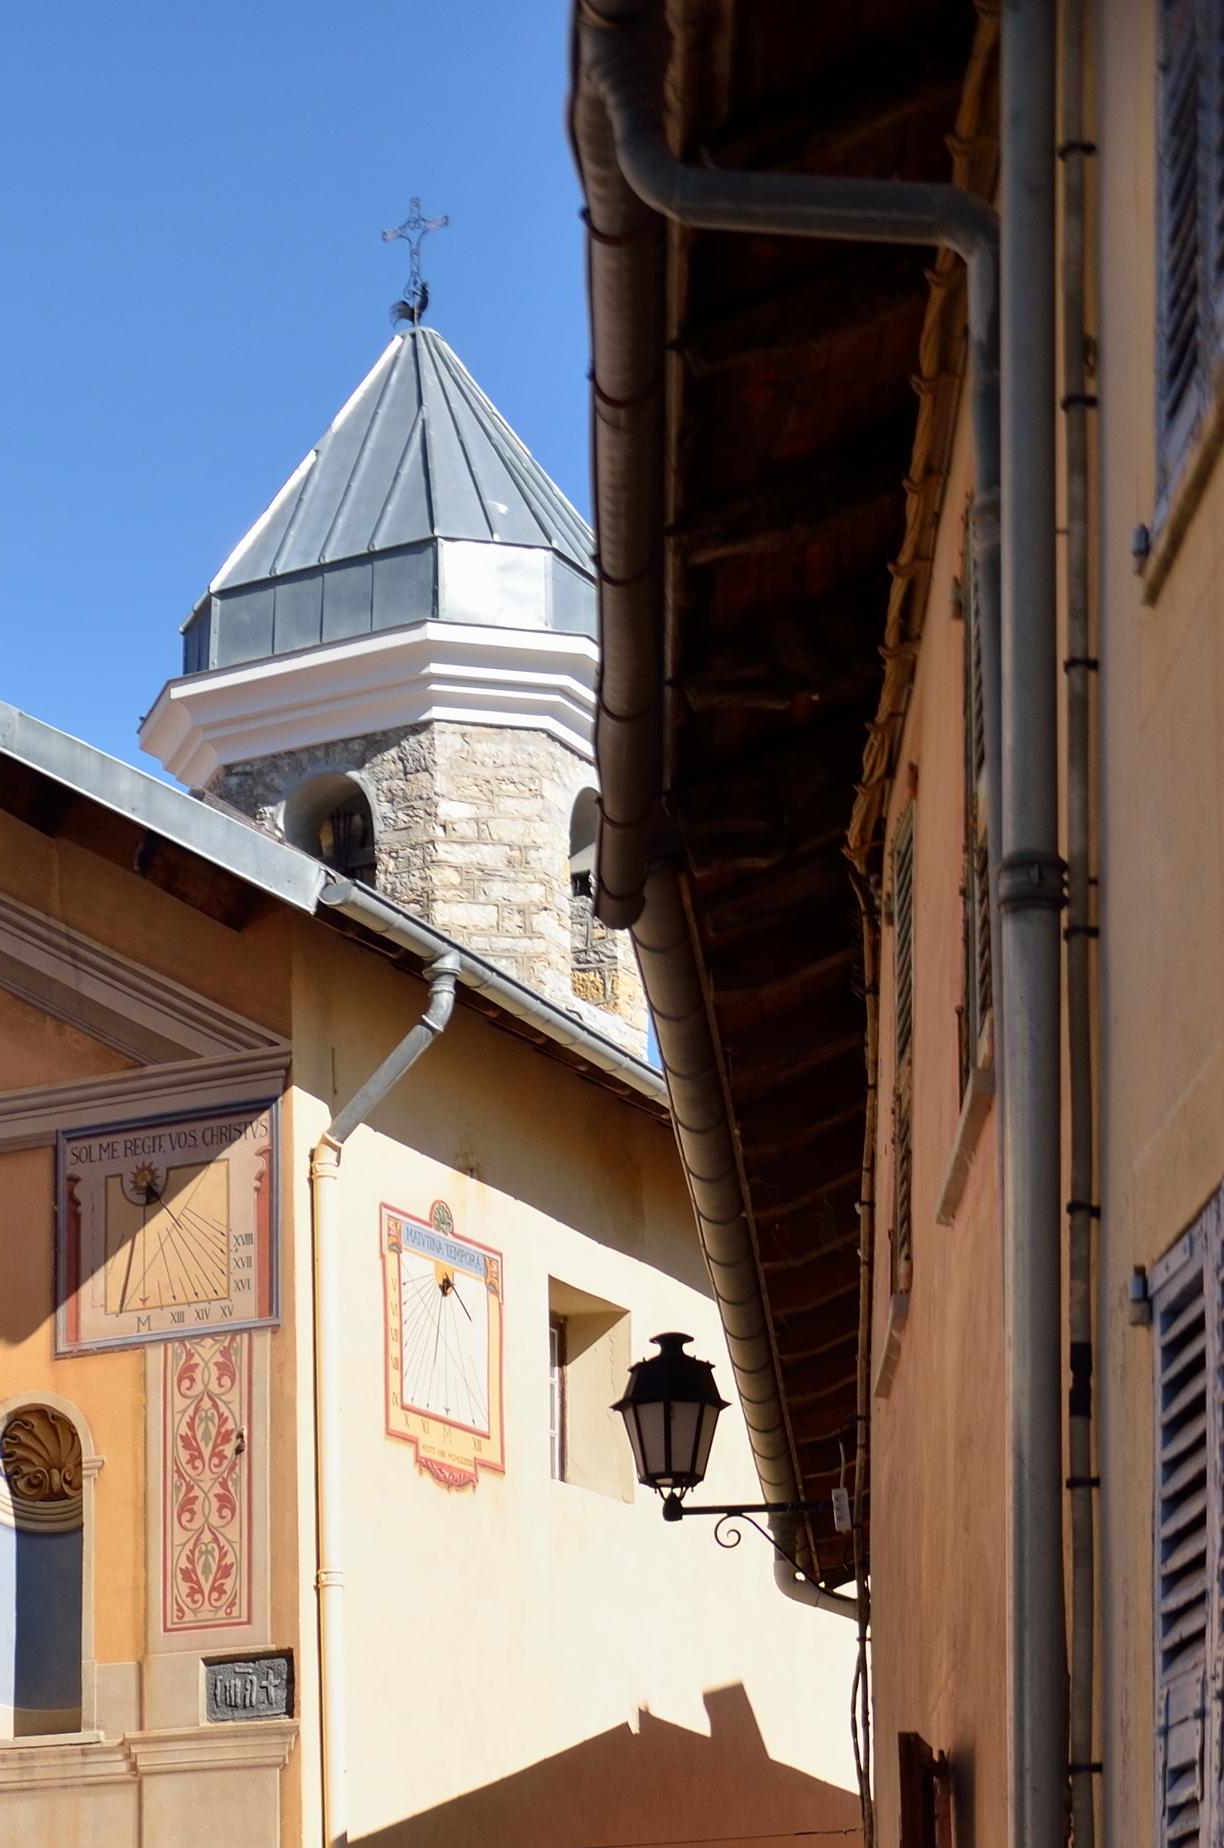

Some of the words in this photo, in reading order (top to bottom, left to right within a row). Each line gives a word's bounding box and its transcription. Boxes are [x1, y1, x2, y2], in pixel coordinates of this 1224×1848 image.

[70, 1145, 96, 1165] SOL
[98, 1141, 120, 1161] ME
[201, 1118, 268, 1147] CHRISTVS
[232, 1255, 252, 1270] XVII
[445, 1243, 482, 1272] TEMPORA
[233, 1278, 251, 1292] XVI
[136, 1315, 152, 1333] M
[195, 1307, 211, 1321] XIV
[220, 1305, 234, 1318] XV
